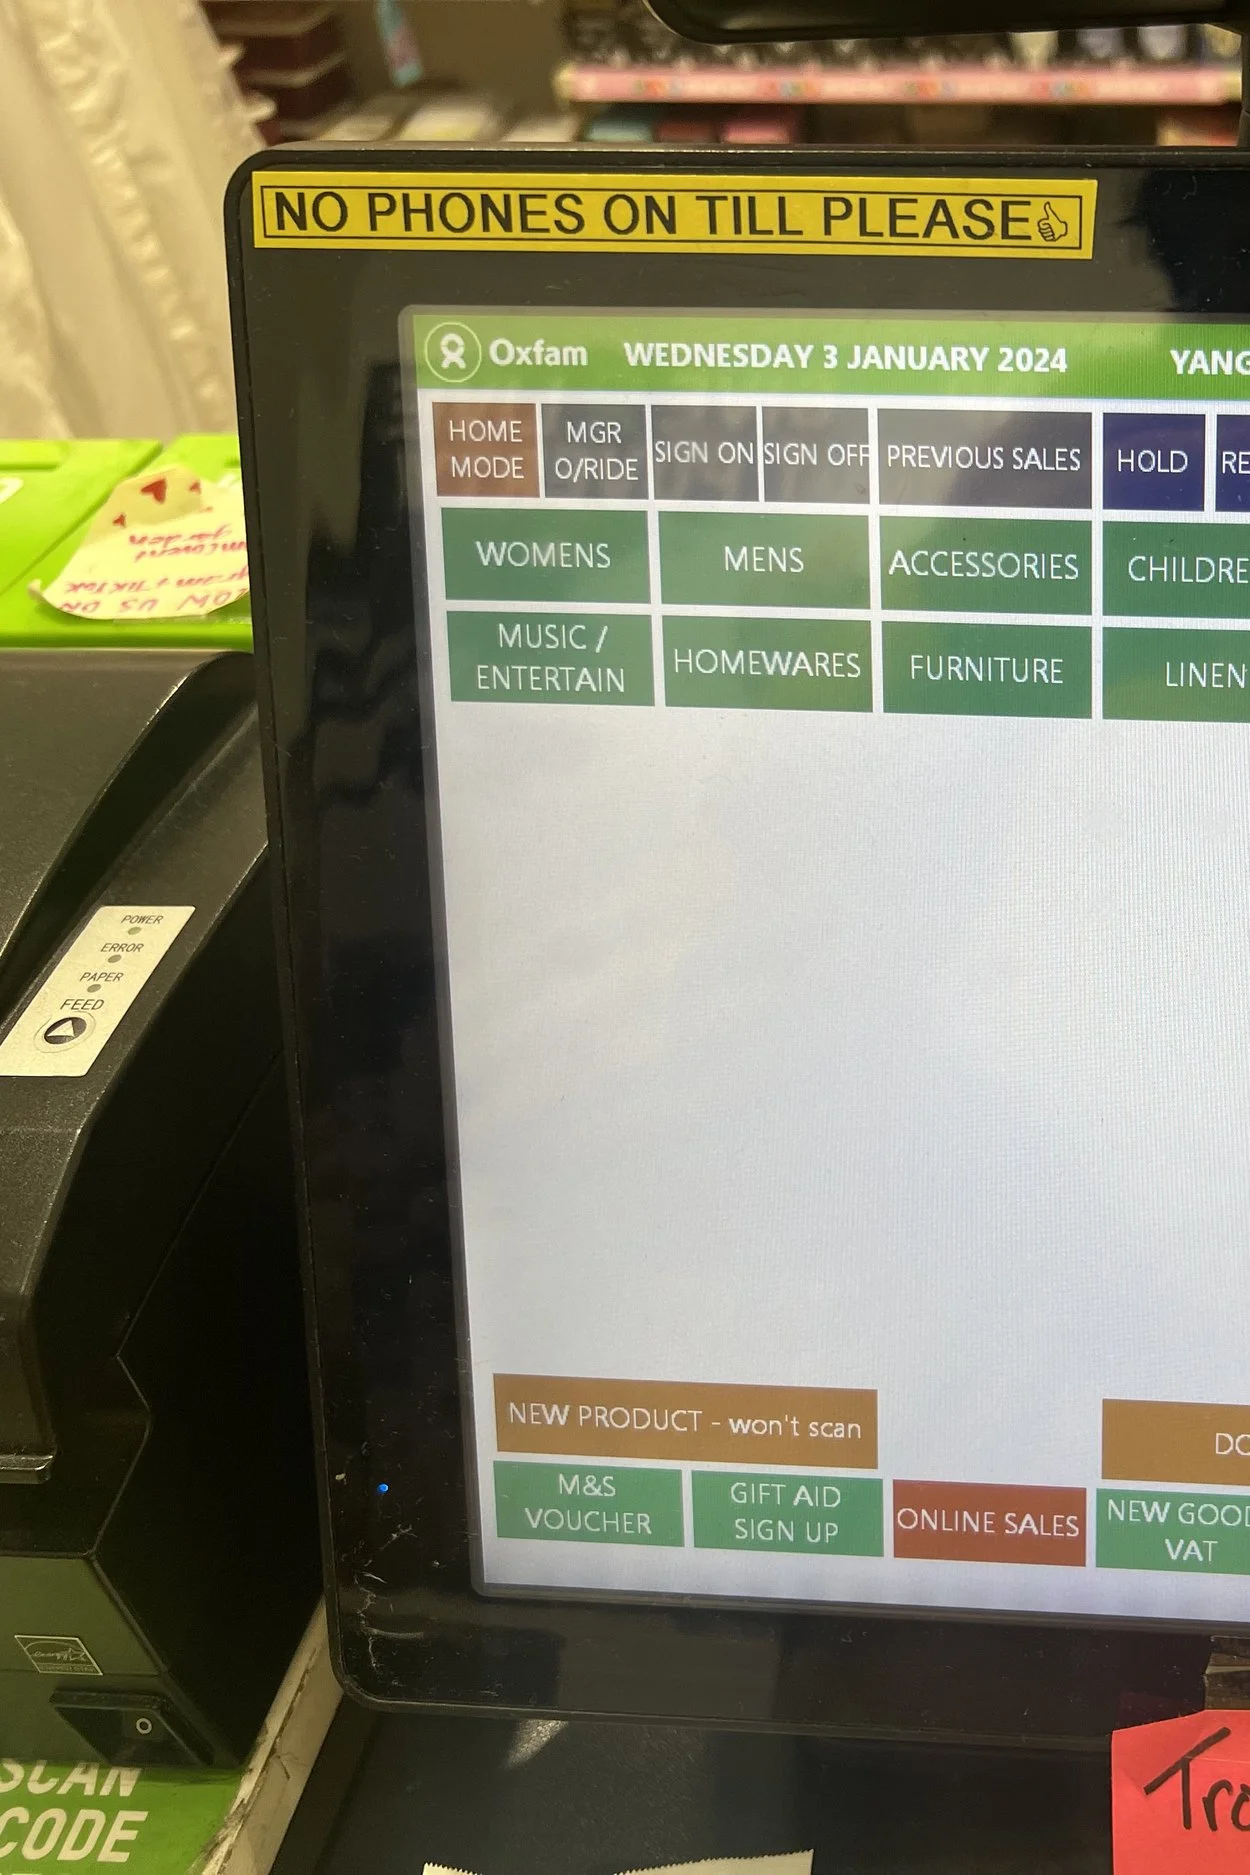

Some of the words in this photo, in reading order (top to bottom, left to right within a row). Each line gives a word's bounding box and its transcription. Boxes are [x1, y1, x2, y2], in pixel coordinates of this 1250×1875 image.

[275, 192, 349, 233] NO
[368, 193, 585, 235] PHONES
[604, 195, 677, 236] ON
[695, 197, 806, 237] TILL
[824, 198, 1034, 241] PLEASE
[490, 339, 587, 367] Oxfam
[624, 342, 815, 370] WEDNESDAY
[824, 345, 840, 370] 3
[845, 345, 989, 371] JANUARY
[997, 347, 1068, 373] 2024
[449, 421, 523, 444] HOME
[566, 421, 622, 445] MGR
[655, 441, 708, 464] SIGN
[716, 441, 754, 465] ON
[764, 443, 819, 467] SIGN
[825, 443, 870, 467] OFF
[887, 444, 1003, 471] PREVIOUS
[1011, 447, 1082, 473] SALES
[1117, 451, 1188, 473] HOLD
[451, 456, 525, 480] MODE
[555, 457, 639, 484] O/RIDE
[477, 542, 610, 568] WOMENS
[724, 546, 804, 572] MENS
[889, 550, 1079, 580] ACCESSORIES
[119, 599, 159, 613] US
[498, 624, 585, 650] MUSIC
[595, 624, 608, 651] /
[674, 649, 861, 678] HOMEWARES
[910, 655, 1063, 685] FURNITURE
[1165, 662, 1246, 689] LINEN
[477, 665, 625, 693] ENTERTAIN
[121, 915, 164, 924] POWER
[100, 943, 144, 953] ERROR
[80, 972, 124, 982] PAPER
[60, 999, 105, 1010] FEED
[509, 1403, 570, 1426] NEW
[579, 1405, 703, 1433] PRODUCT
[729, 1414, 799, 1438] won't
[809, 1419, 862, 1440] scan
[558, 1474, 616, 1497] M&S
[731, 1482, 786, 1506] GIFT
[793, 1485, 841, 1508] AID
[525, 1508, 652, 1535] VOUCHER
[897, 1507, 995, 1534] ONLINE
[1005, 1512, 1079, 1538] SALES
[1107, 1500, 1171, 1524] NEW
[735, 1519, 795, 1542] SIGN
[806, 1521, 838, 1544] UP
[1165, 1539, 1218, 1562] VAT
[0, 1757, 142, 1797] SCAN
[0, 1806, 149, 1863] CODE
